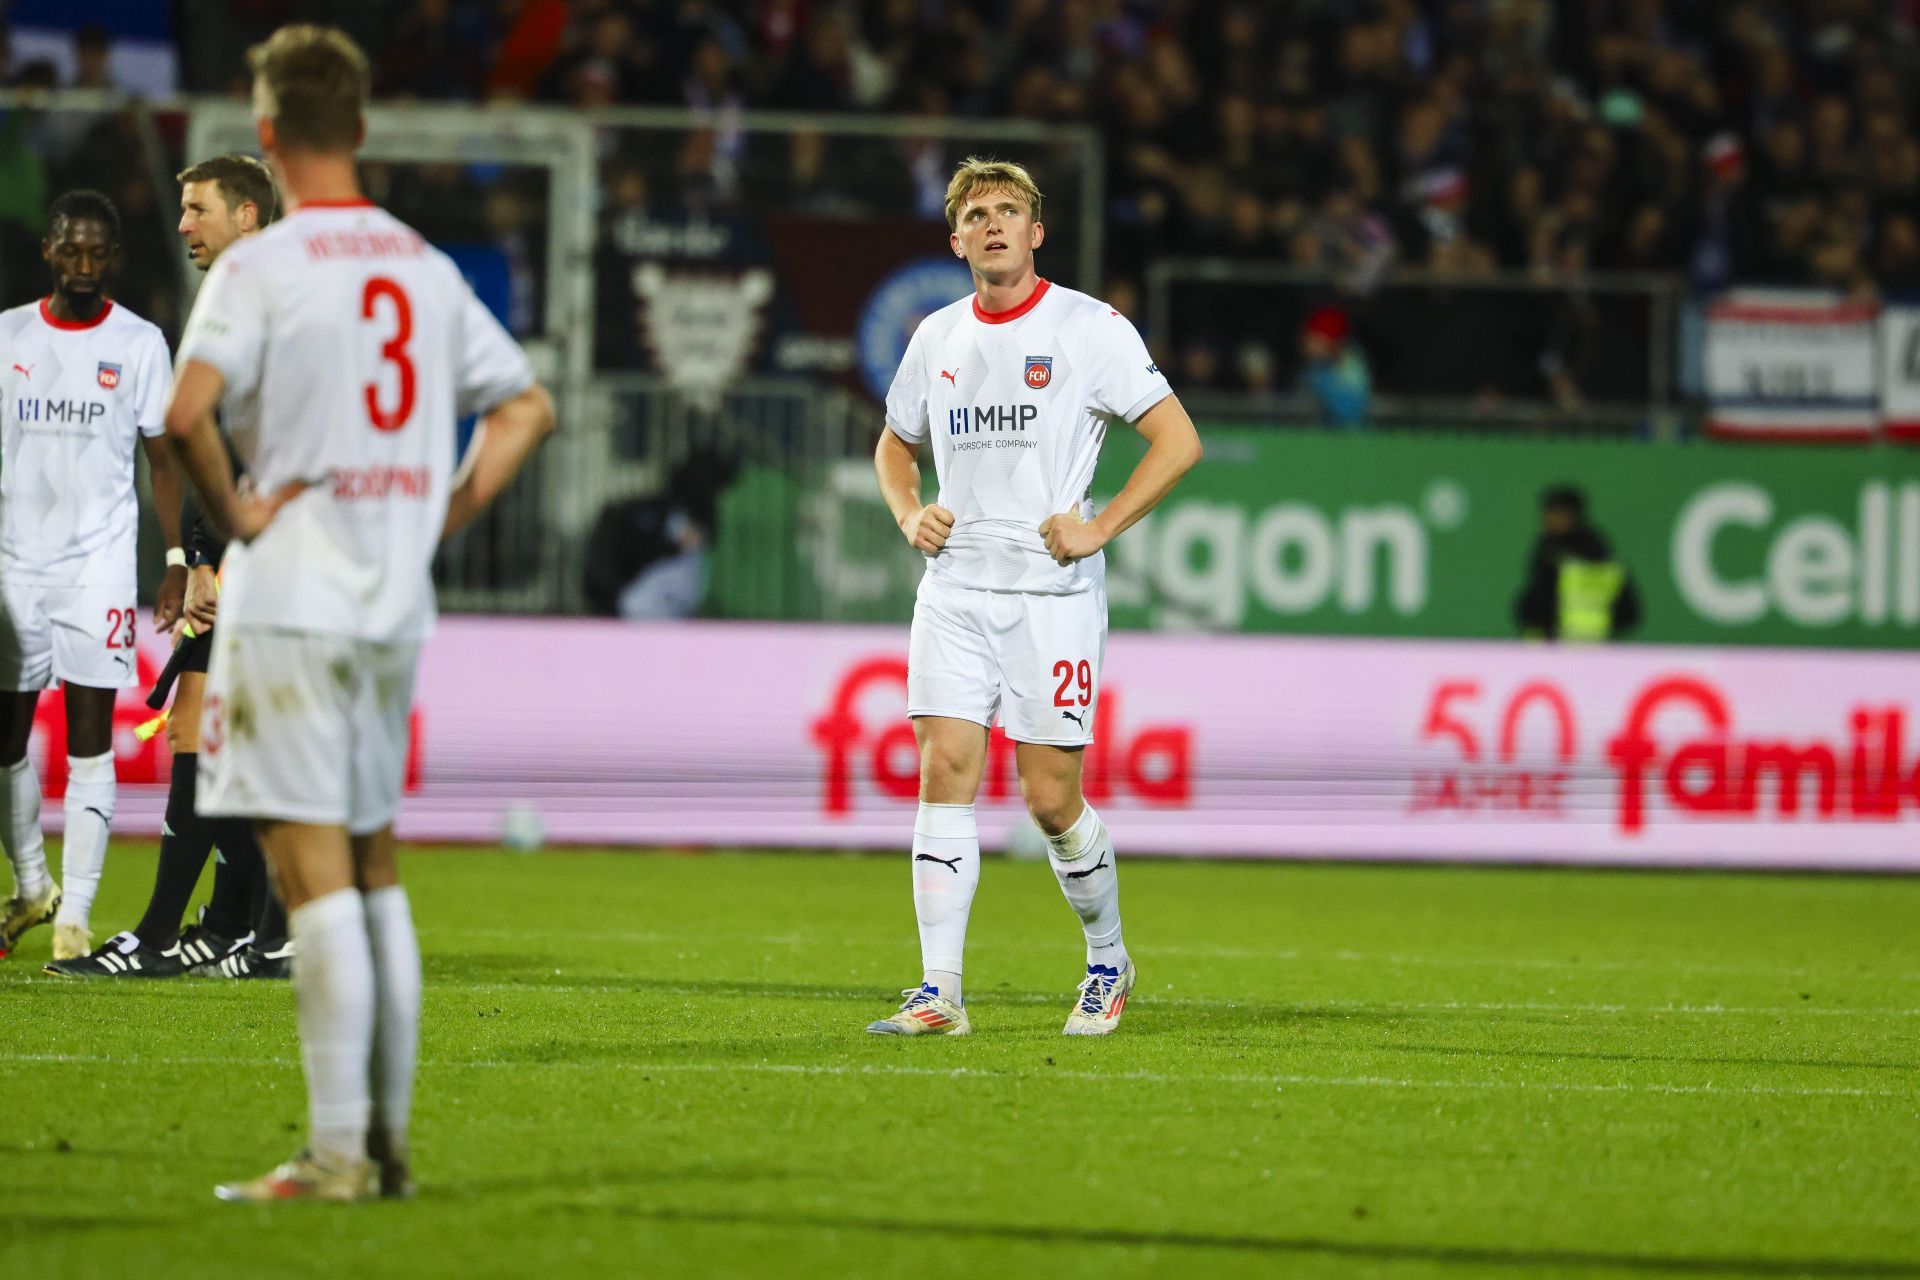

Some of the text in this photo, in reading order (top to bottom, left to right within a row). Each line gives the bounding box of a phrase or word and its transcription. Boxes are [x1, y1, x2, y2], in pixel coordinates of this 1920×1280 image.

[362, 276, 416, 433] 3
[1029, 370, 1047, 381] FCH
[46, 399, 105, 424] MHP
[974, 404, 1038, 432] MHP
[957, 441, 993, 452] PORSCHE
[995, 439, 1038, 450] COMPANY
[106, 608, 137, 649] 23
[1052, 658, 1092, 708] 29
[1607, 675, 1920, 836] famil
